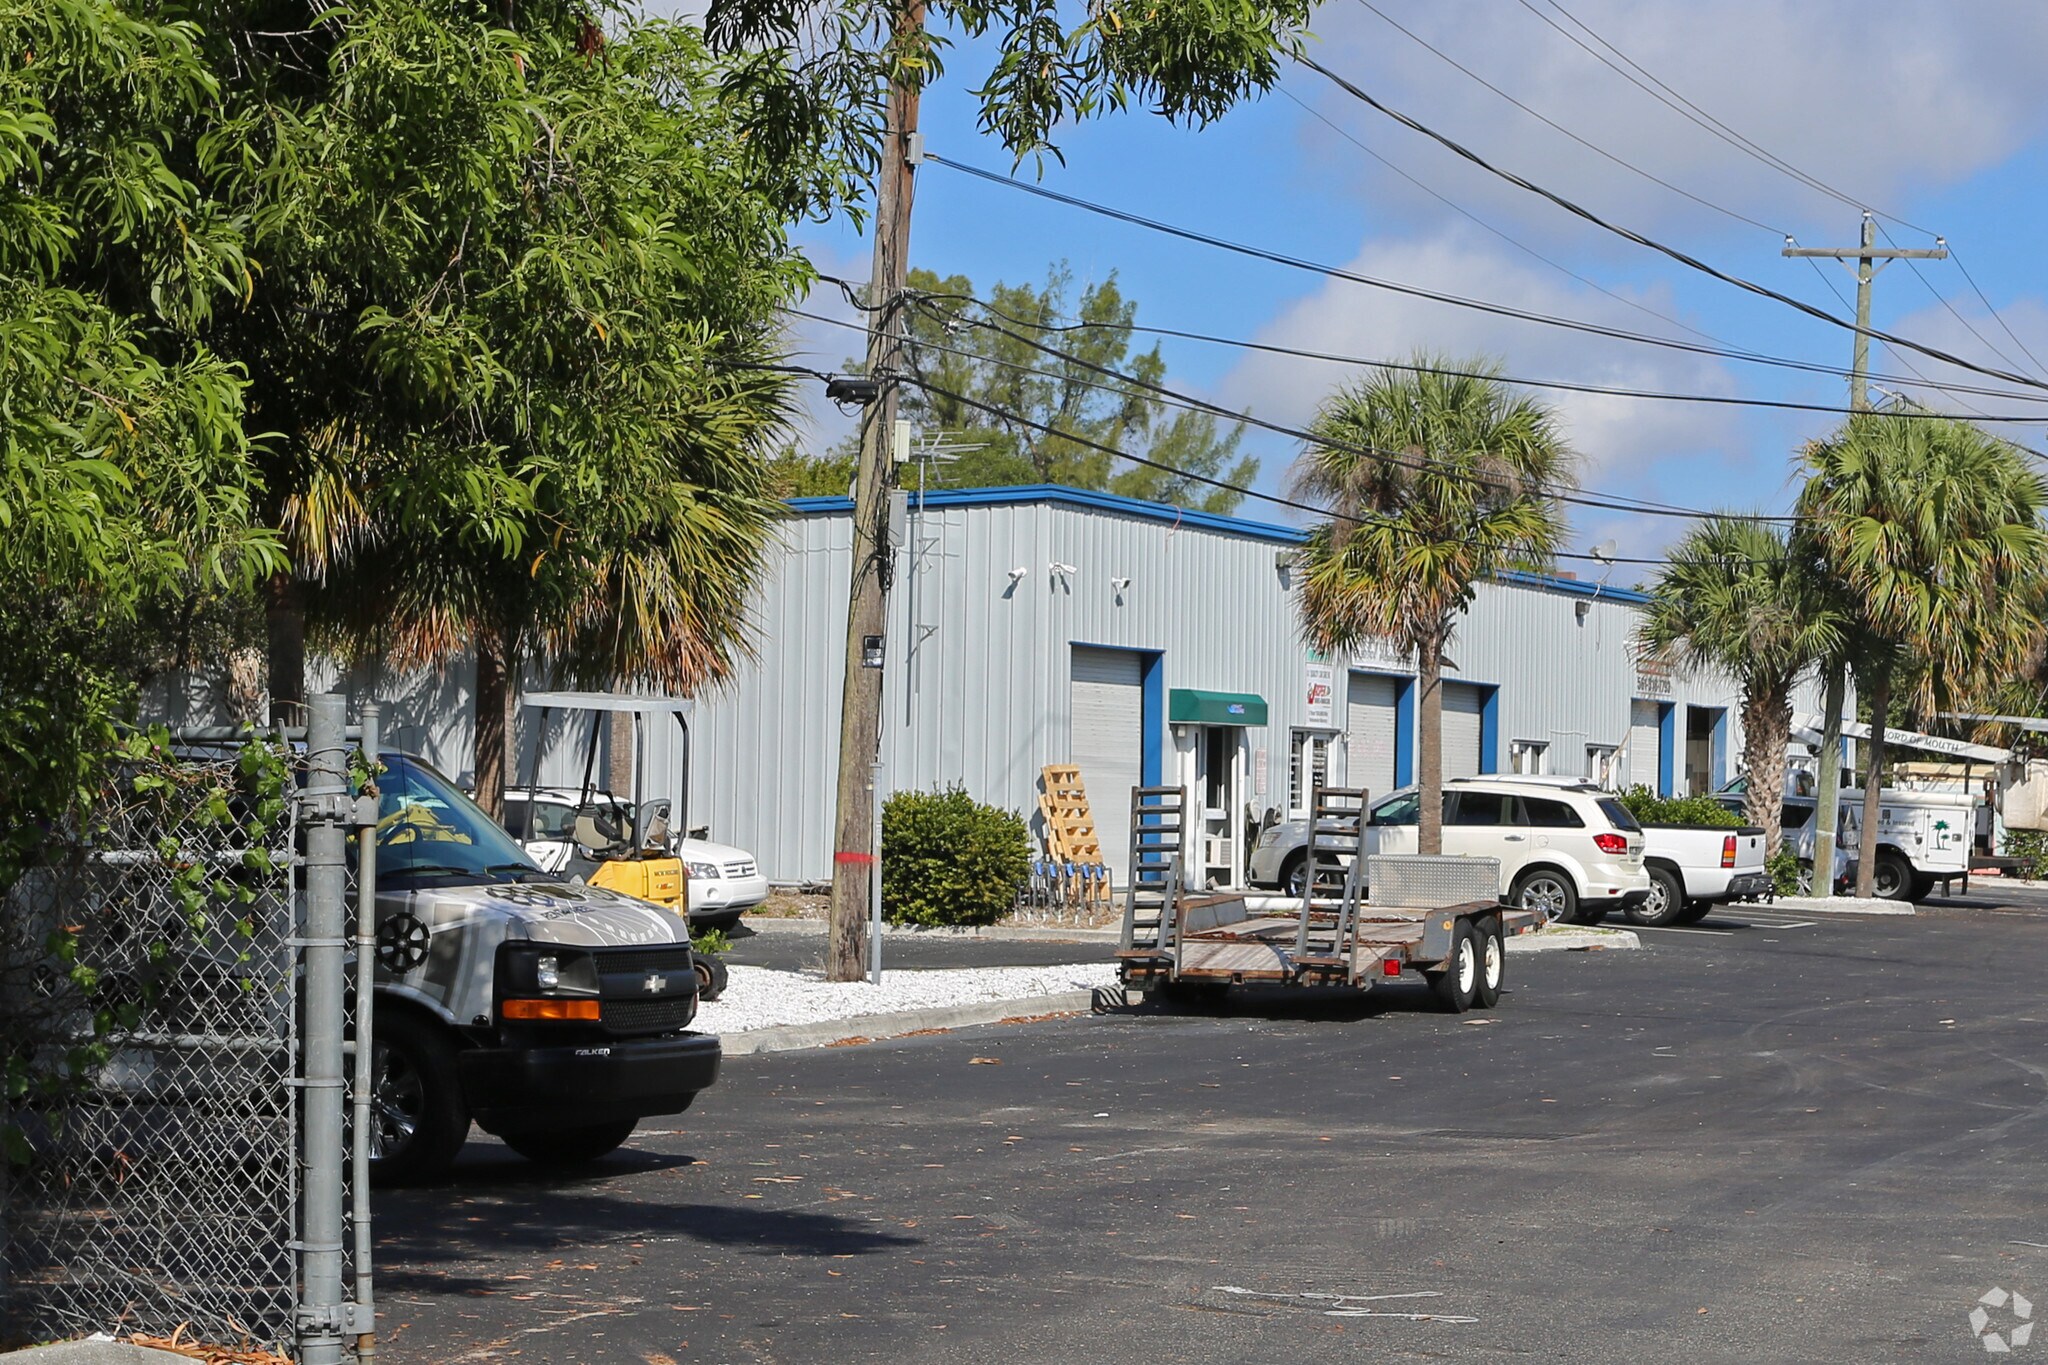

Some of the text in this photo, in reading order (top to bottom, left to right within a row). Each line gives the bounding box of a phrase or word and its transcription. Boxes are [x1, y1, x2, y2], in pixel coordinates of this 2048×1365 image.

[1909, 735, 1923, 744] OF
[1924, 737, 1959, 752] MOUTH
[575, 1048, 610, 1056] FALKEN
